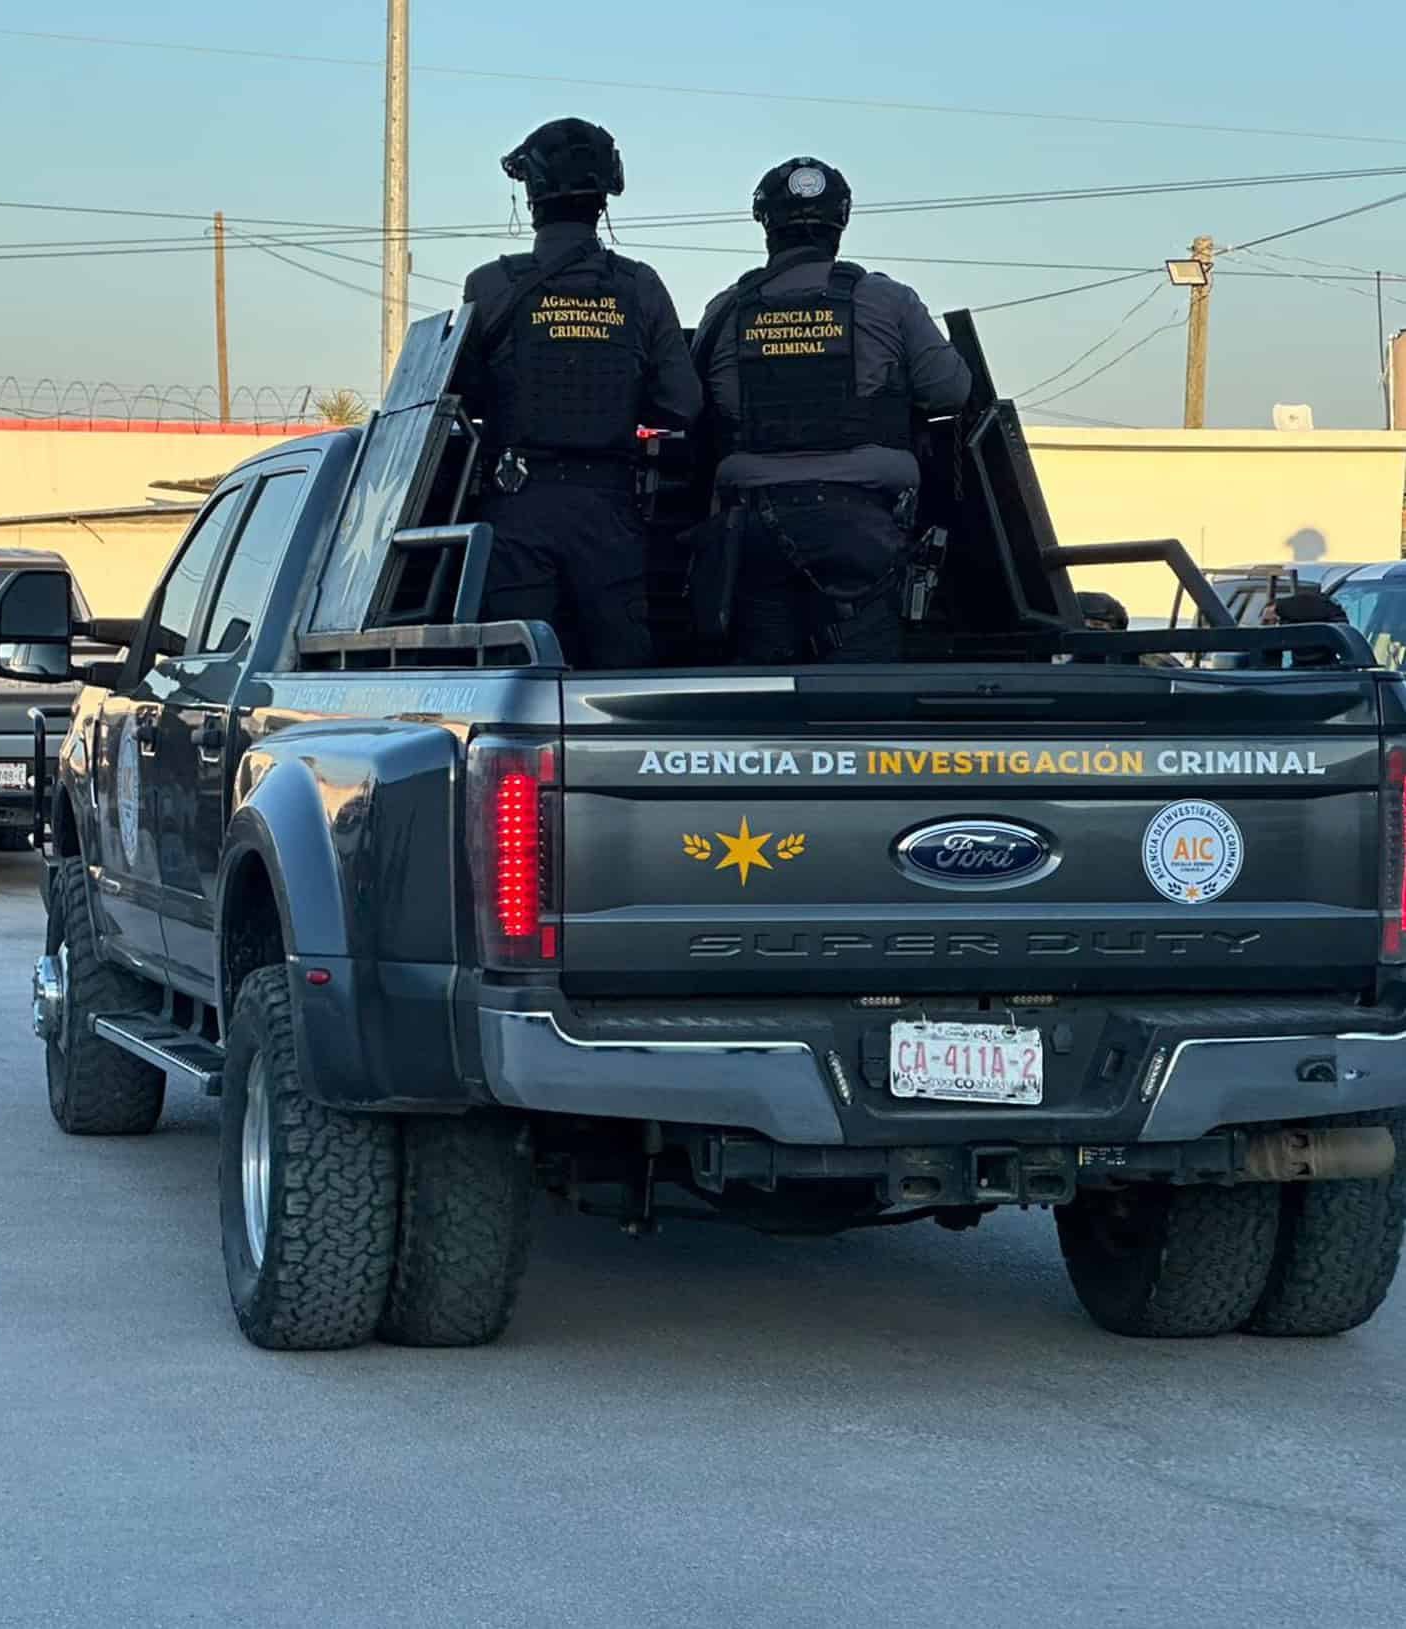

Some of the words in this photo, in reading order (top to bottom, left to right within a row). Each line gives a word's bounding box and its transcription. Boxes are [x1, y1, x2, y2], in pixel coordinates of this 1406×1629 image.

[540, 296, 598, 308] AGENCIA
[600, 297, 617, 309] DE
[532, 310, 625, 325] INVESTIGACIÓN
[755, 311, 813, 325] AGENCIA
[815, 309, 834, 322] DE
[549, 325, 610, 339] CRIMINAL
[745, 323, 843, 340] INVESTIGACIÓN
[762, 341, 825, 355] CRIMINAL
[638, 750, 800, 775] AGENCIA
[811, 751, 857, 775] DE
[867, 743, 1144, 775] INVESTIGACIÓN
[1157, 750, 1325, 775] CRIMINAL
[936, 833, 1017, 868] Ford
[1173, 837, 1215, 861] AIC
[690, 932, 1000, 958] SUPER
[1027, 932, 1261, 958] DUTY
[898, 1040, 1037, 1080] CA-411A-2
